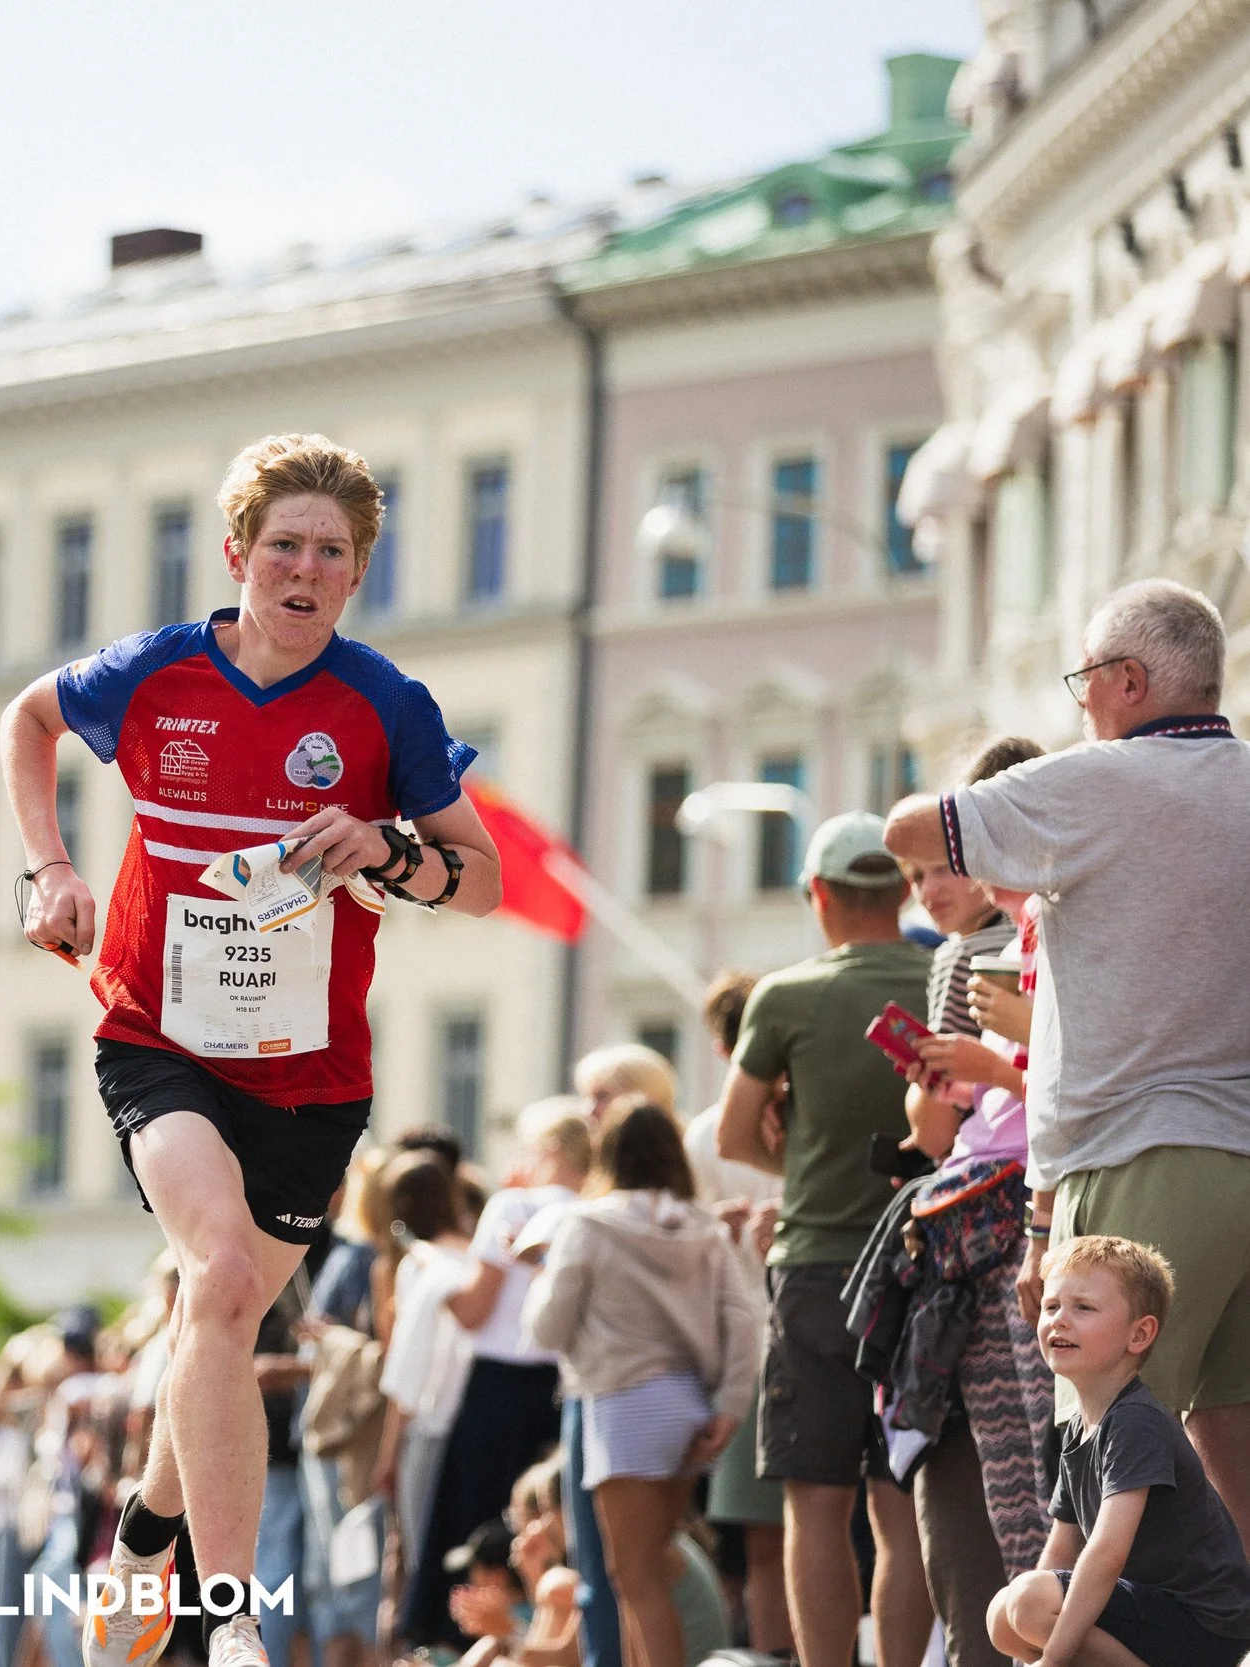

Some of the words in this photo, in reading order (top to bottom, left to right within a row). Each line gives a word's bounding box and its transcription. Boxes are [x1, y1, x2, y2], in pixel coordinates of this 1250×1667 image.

[155, 716, 220, 734] TRIMTEX
[158, 787, 207, 802] ALEWALDS
[266, 798, 350, 814] LUMONE
[257, 894, 308, 923] CHALMERS
[183, 908, 302, 935] bagh
[224, 945, 272, 963] 9235
[219, 971, 276, 988] RUARI
[203, 1041, 249, 1050] CHALMERS
